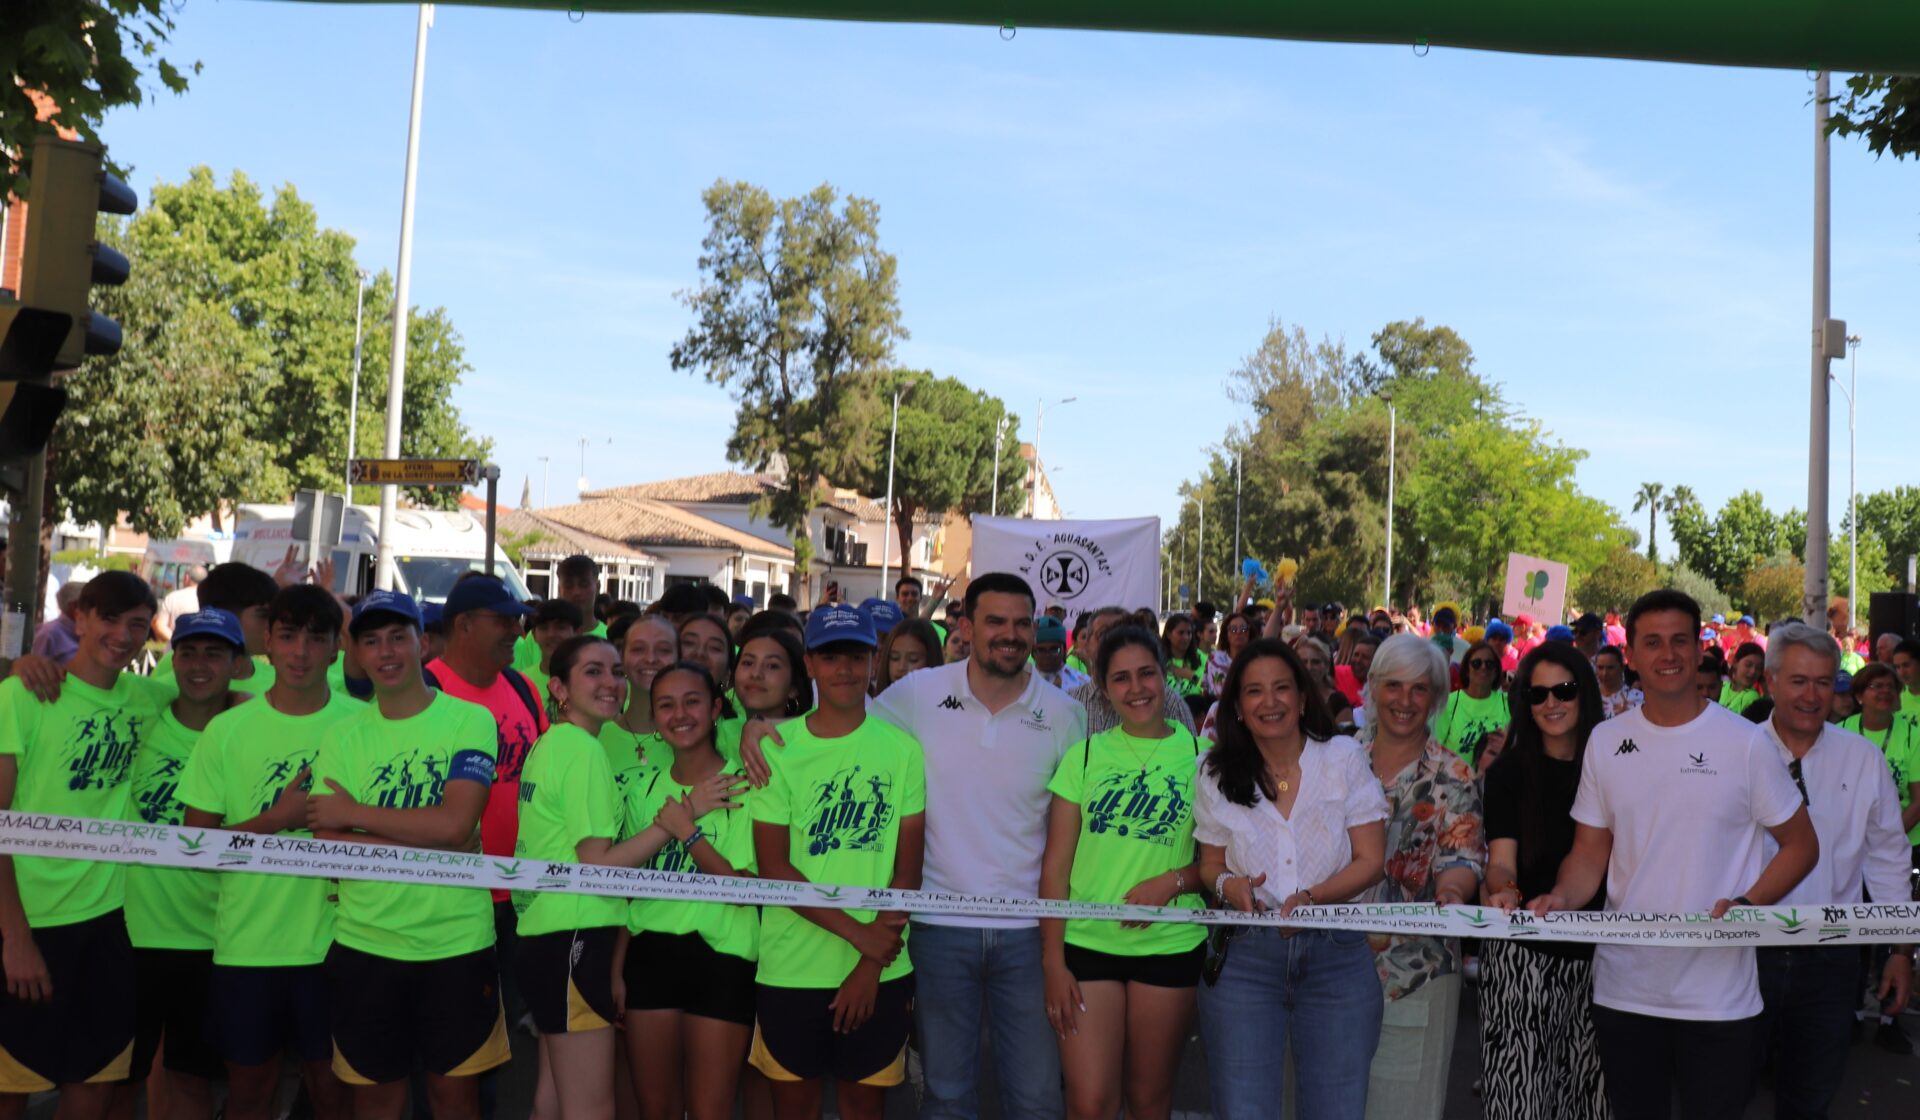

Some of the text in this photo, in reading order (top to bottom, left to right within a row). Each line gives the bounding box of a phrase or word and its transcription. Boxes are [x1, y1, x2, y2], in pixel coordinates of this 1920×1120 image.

[86, 821, 169, 841] DEPORTE
[100, 845, 108, 854] y
[262, 837, 485, 867] EXTREMADURA DEPORTE
[261, 856, 310, 867] Dirección
[311, 860, 353, 870] General
[354, 863, 369, 871] de
[416, 869, 425, 878] y
[426, 868, 475, 880] Deportes
[580, 866, 804, 892] EXTREMADURA DEPORTE
[901, 892, 1041, 907] EXTREMADURA
[1367, 905, 1450, 917] DEPORTE
[1389, 919, 1397, 927] y
[1399, 919, 1447, 929] Deportes
[1600, 929, 1640, 938] General
[1642, 929, 1656, 938] de
[1659, 928, 1702, 939] Jóvenes
[1704, 930, 1712, 940] y
[1713, 929, 1760, 940] Deportes
[1859, 926, 1904, 936] Dirección
